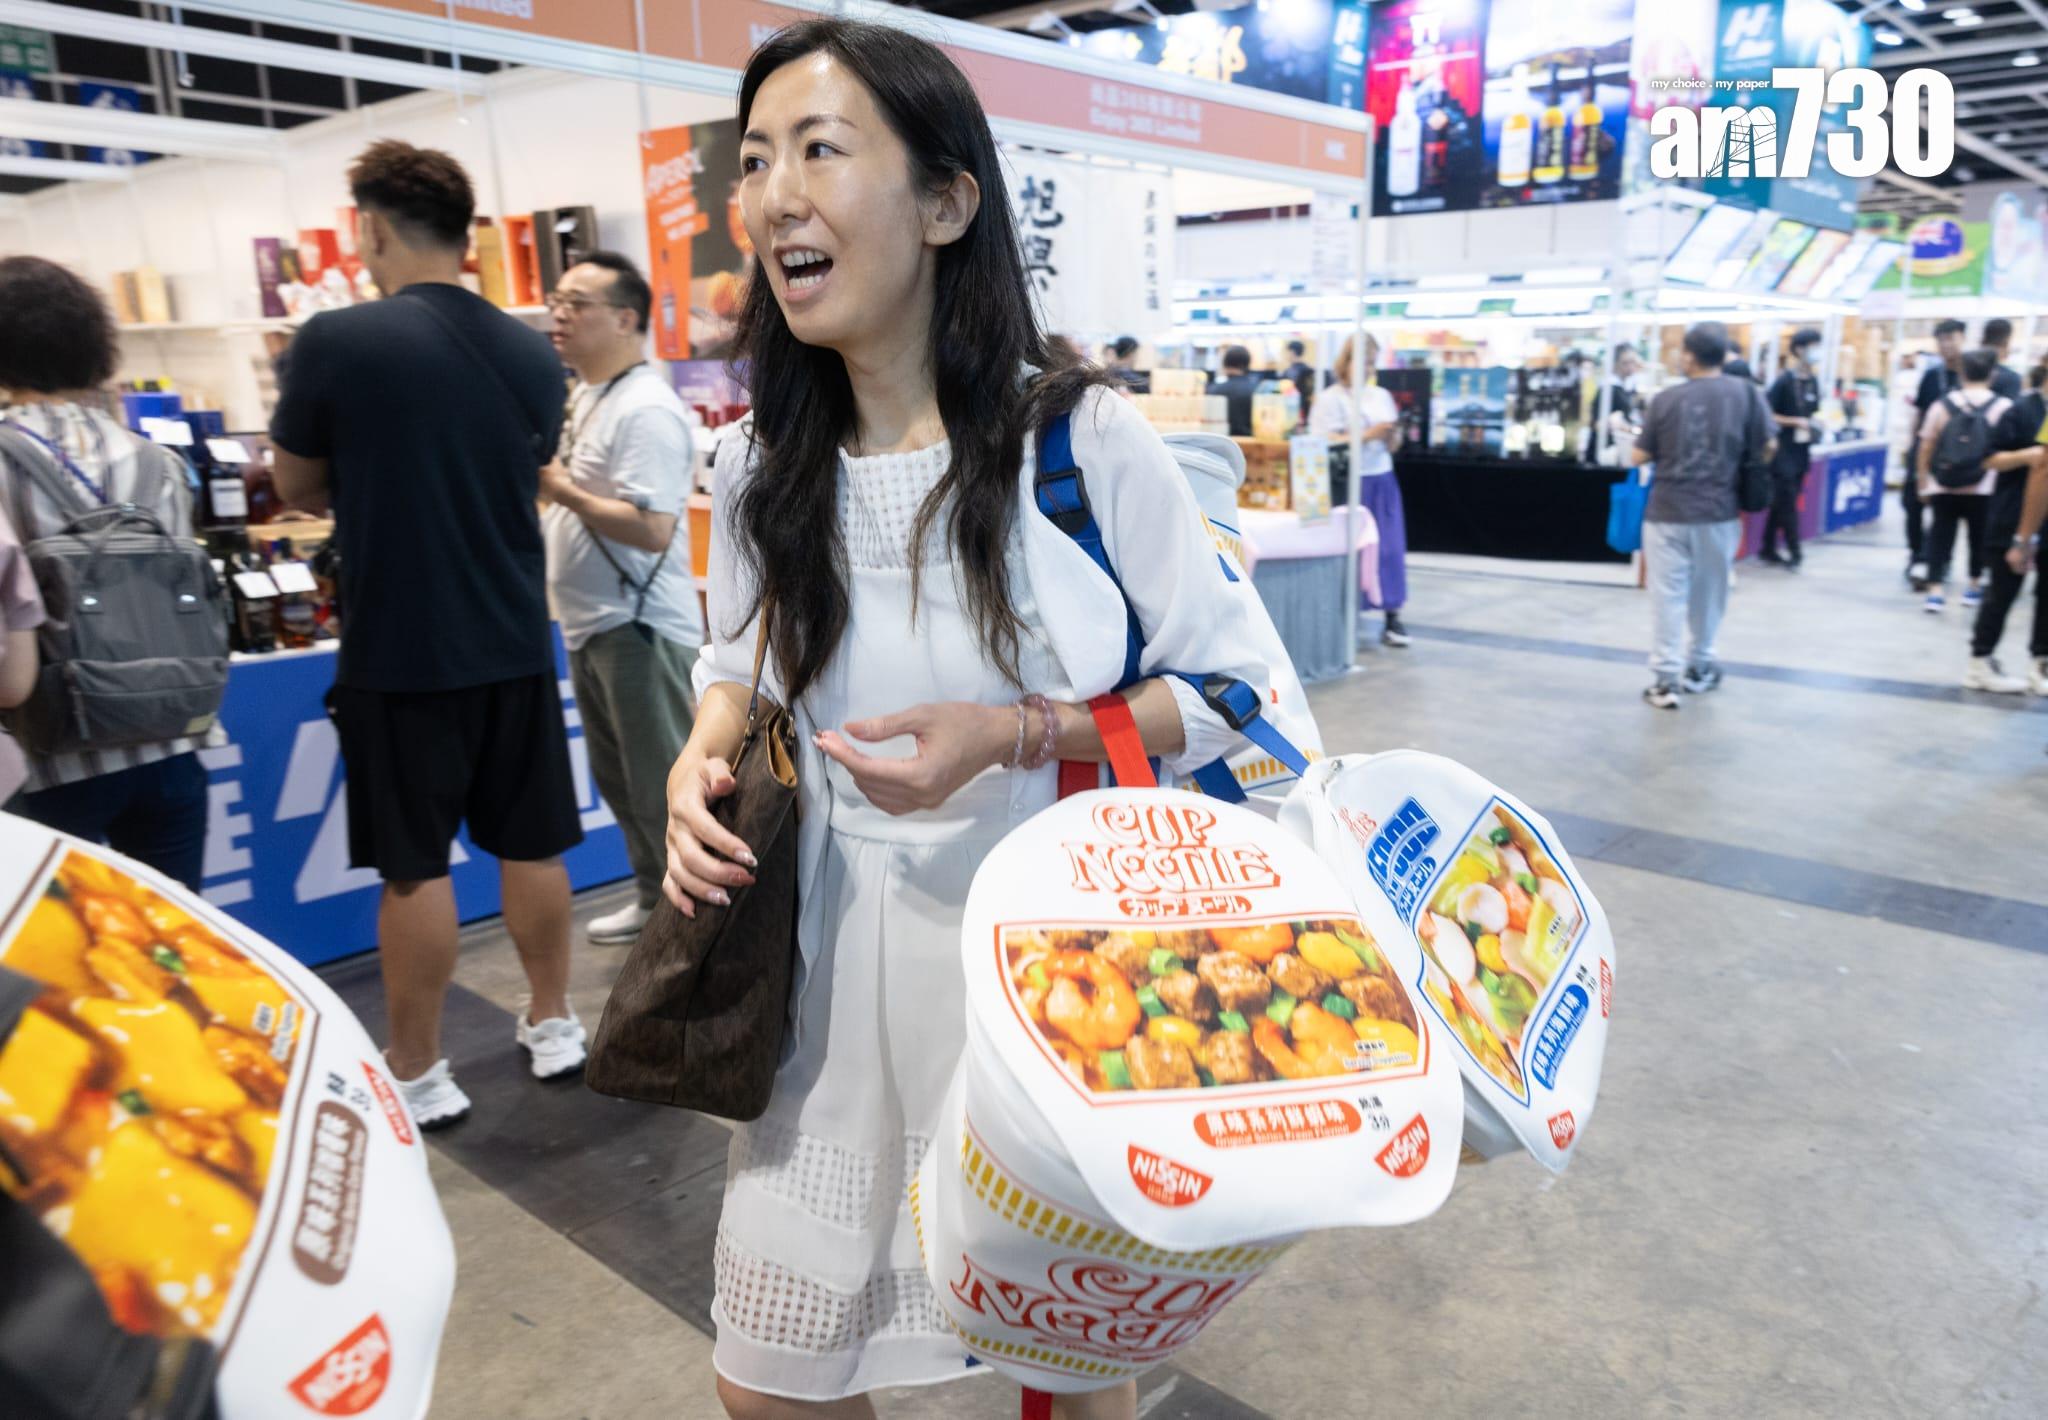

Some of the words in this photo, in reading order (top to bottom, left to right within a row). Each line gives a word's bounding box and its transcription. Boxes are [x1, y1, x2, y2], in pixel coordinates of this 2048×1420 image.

[1092, 801, 1217, 850] CUP
[1061, 842, 1282, 895] NOODLE
[1384, 1121, 1428, 1175] NISSIN
[1133, 1151, 1203, 1200] NISSIN
[303, 1328, 388, 1408] NISSIN
